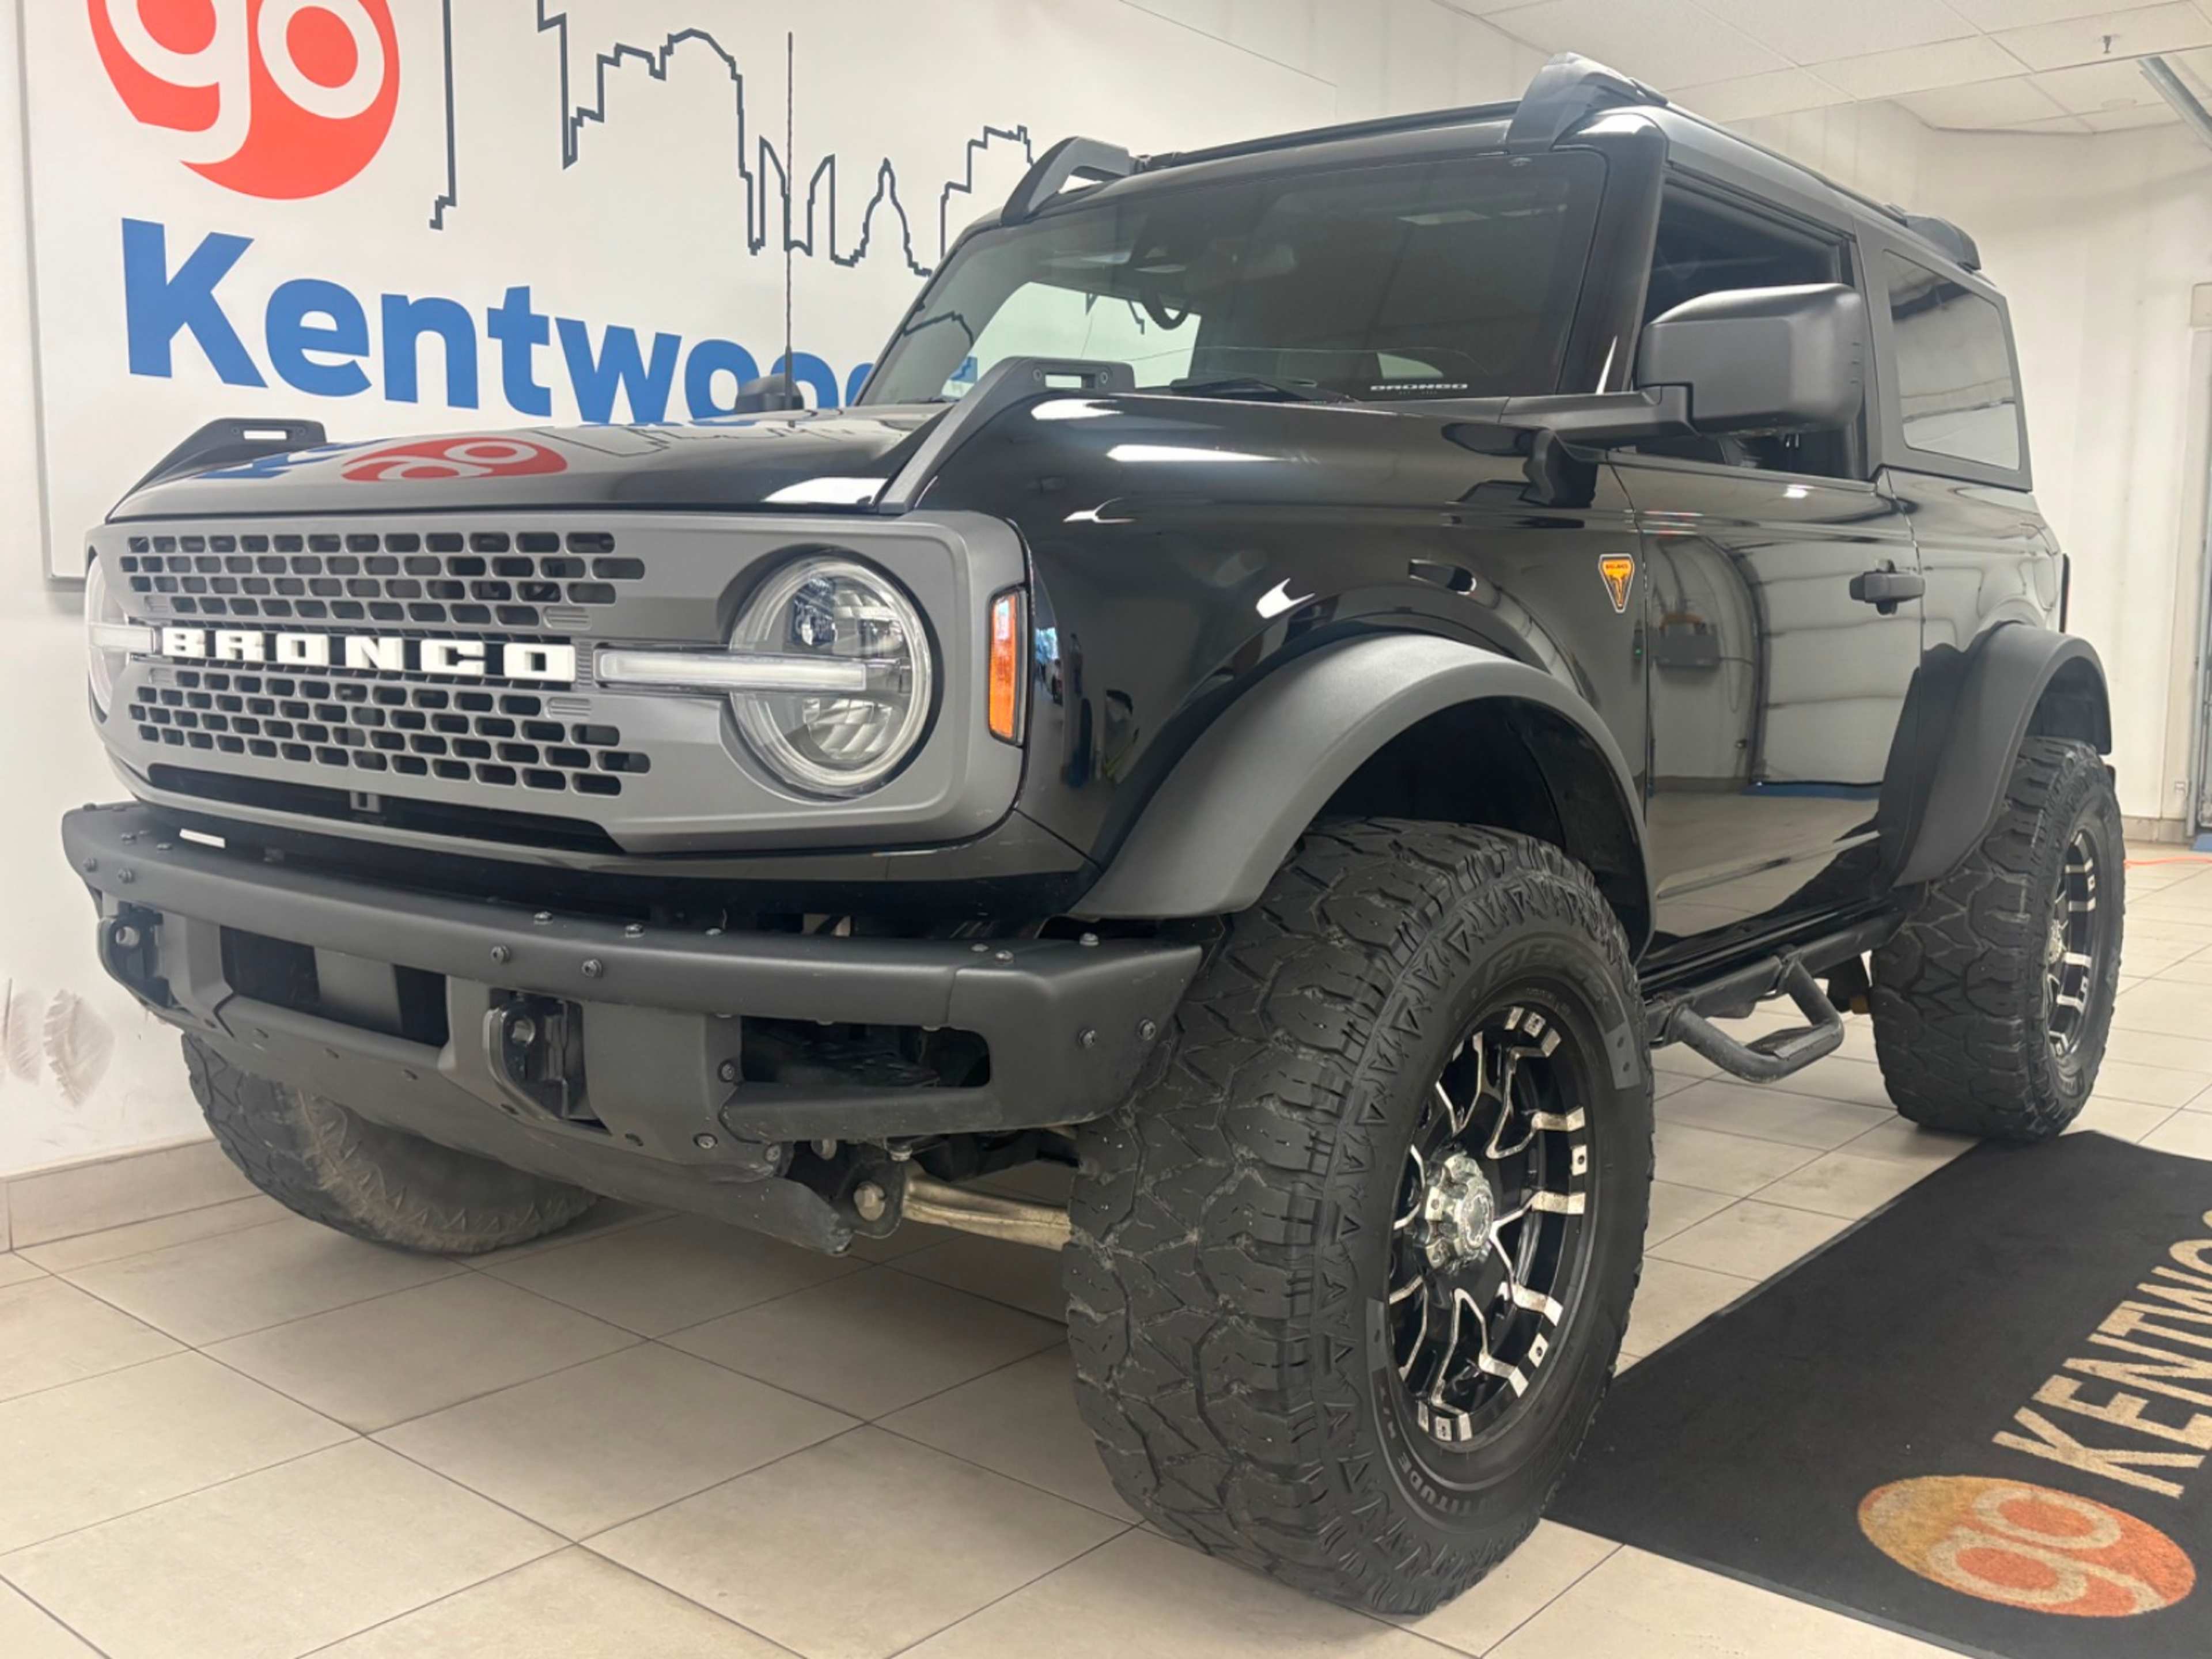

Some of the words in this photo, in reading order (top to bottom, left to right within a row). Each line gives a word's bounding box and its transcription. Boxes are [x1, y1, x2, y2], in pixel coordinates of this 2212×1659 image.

[105, 0, 385, 164] go
[121, 217, 876, 425] Kentwoo
[162, 627, 576, 682] BRONCO
[1991, 1210, 2212, 1499] KENT
